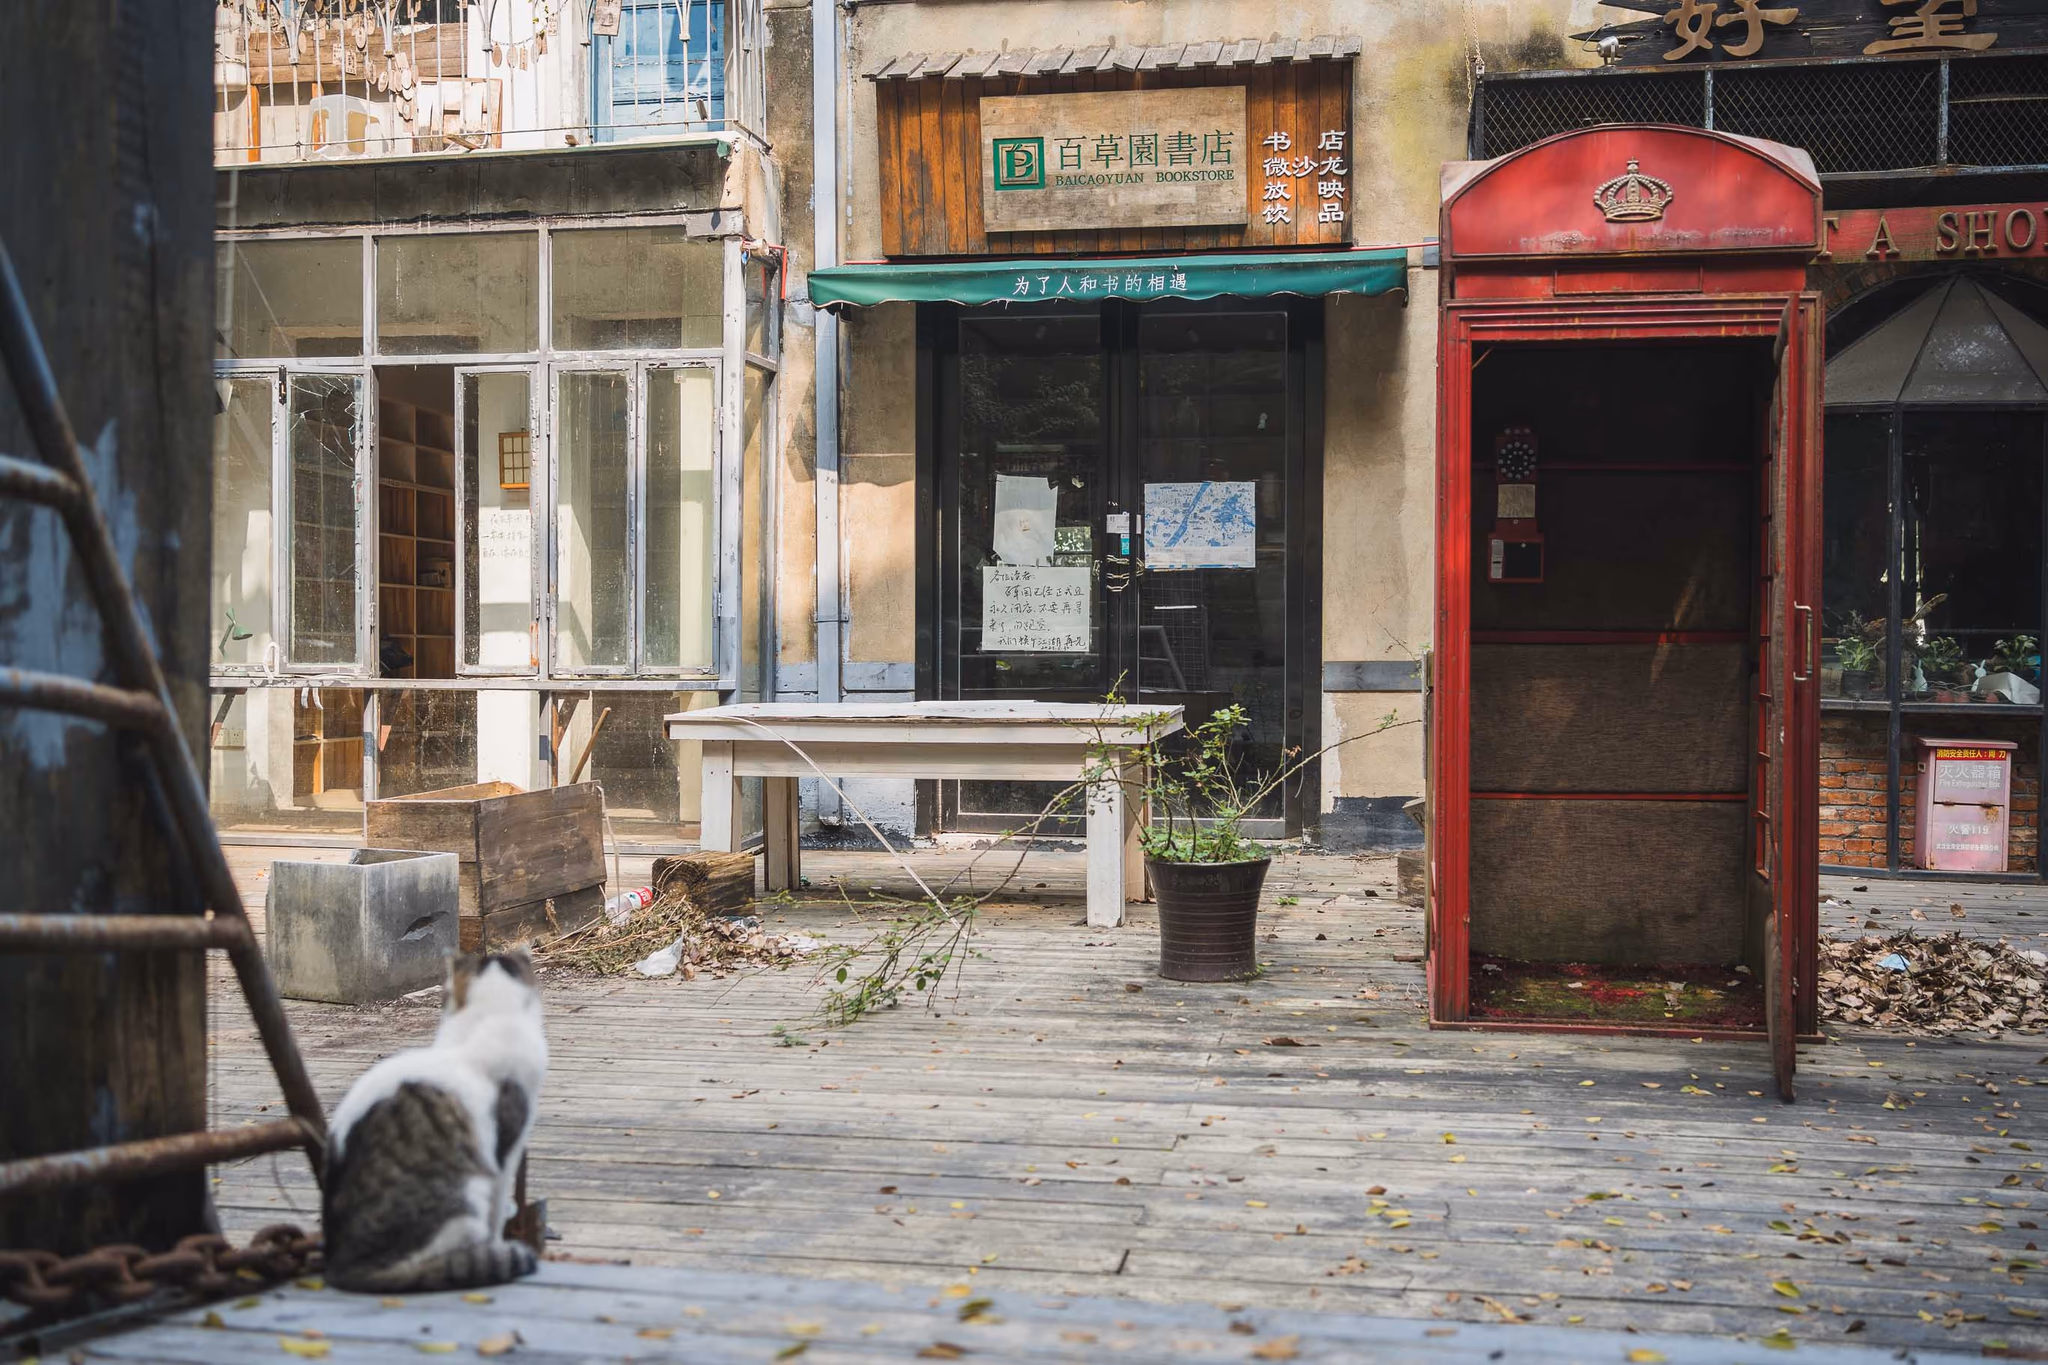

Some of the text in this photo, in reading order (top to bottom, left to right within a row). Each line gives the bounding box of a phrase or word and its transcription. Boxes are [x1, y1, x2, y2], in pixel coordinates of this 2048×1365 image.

[1053, 129, 1234, 170] 百草園書店
[1055, 169, 1234, 186] BAICAOYUAN BOOKSTORE
[1865, 214, 1900, 256] A
[1936, 208, 2048, 254] SHO
[1012, 273, 1188, 295] 为了人和书的相遇
[1939, 764, 2003, 780] 灭火器箱
